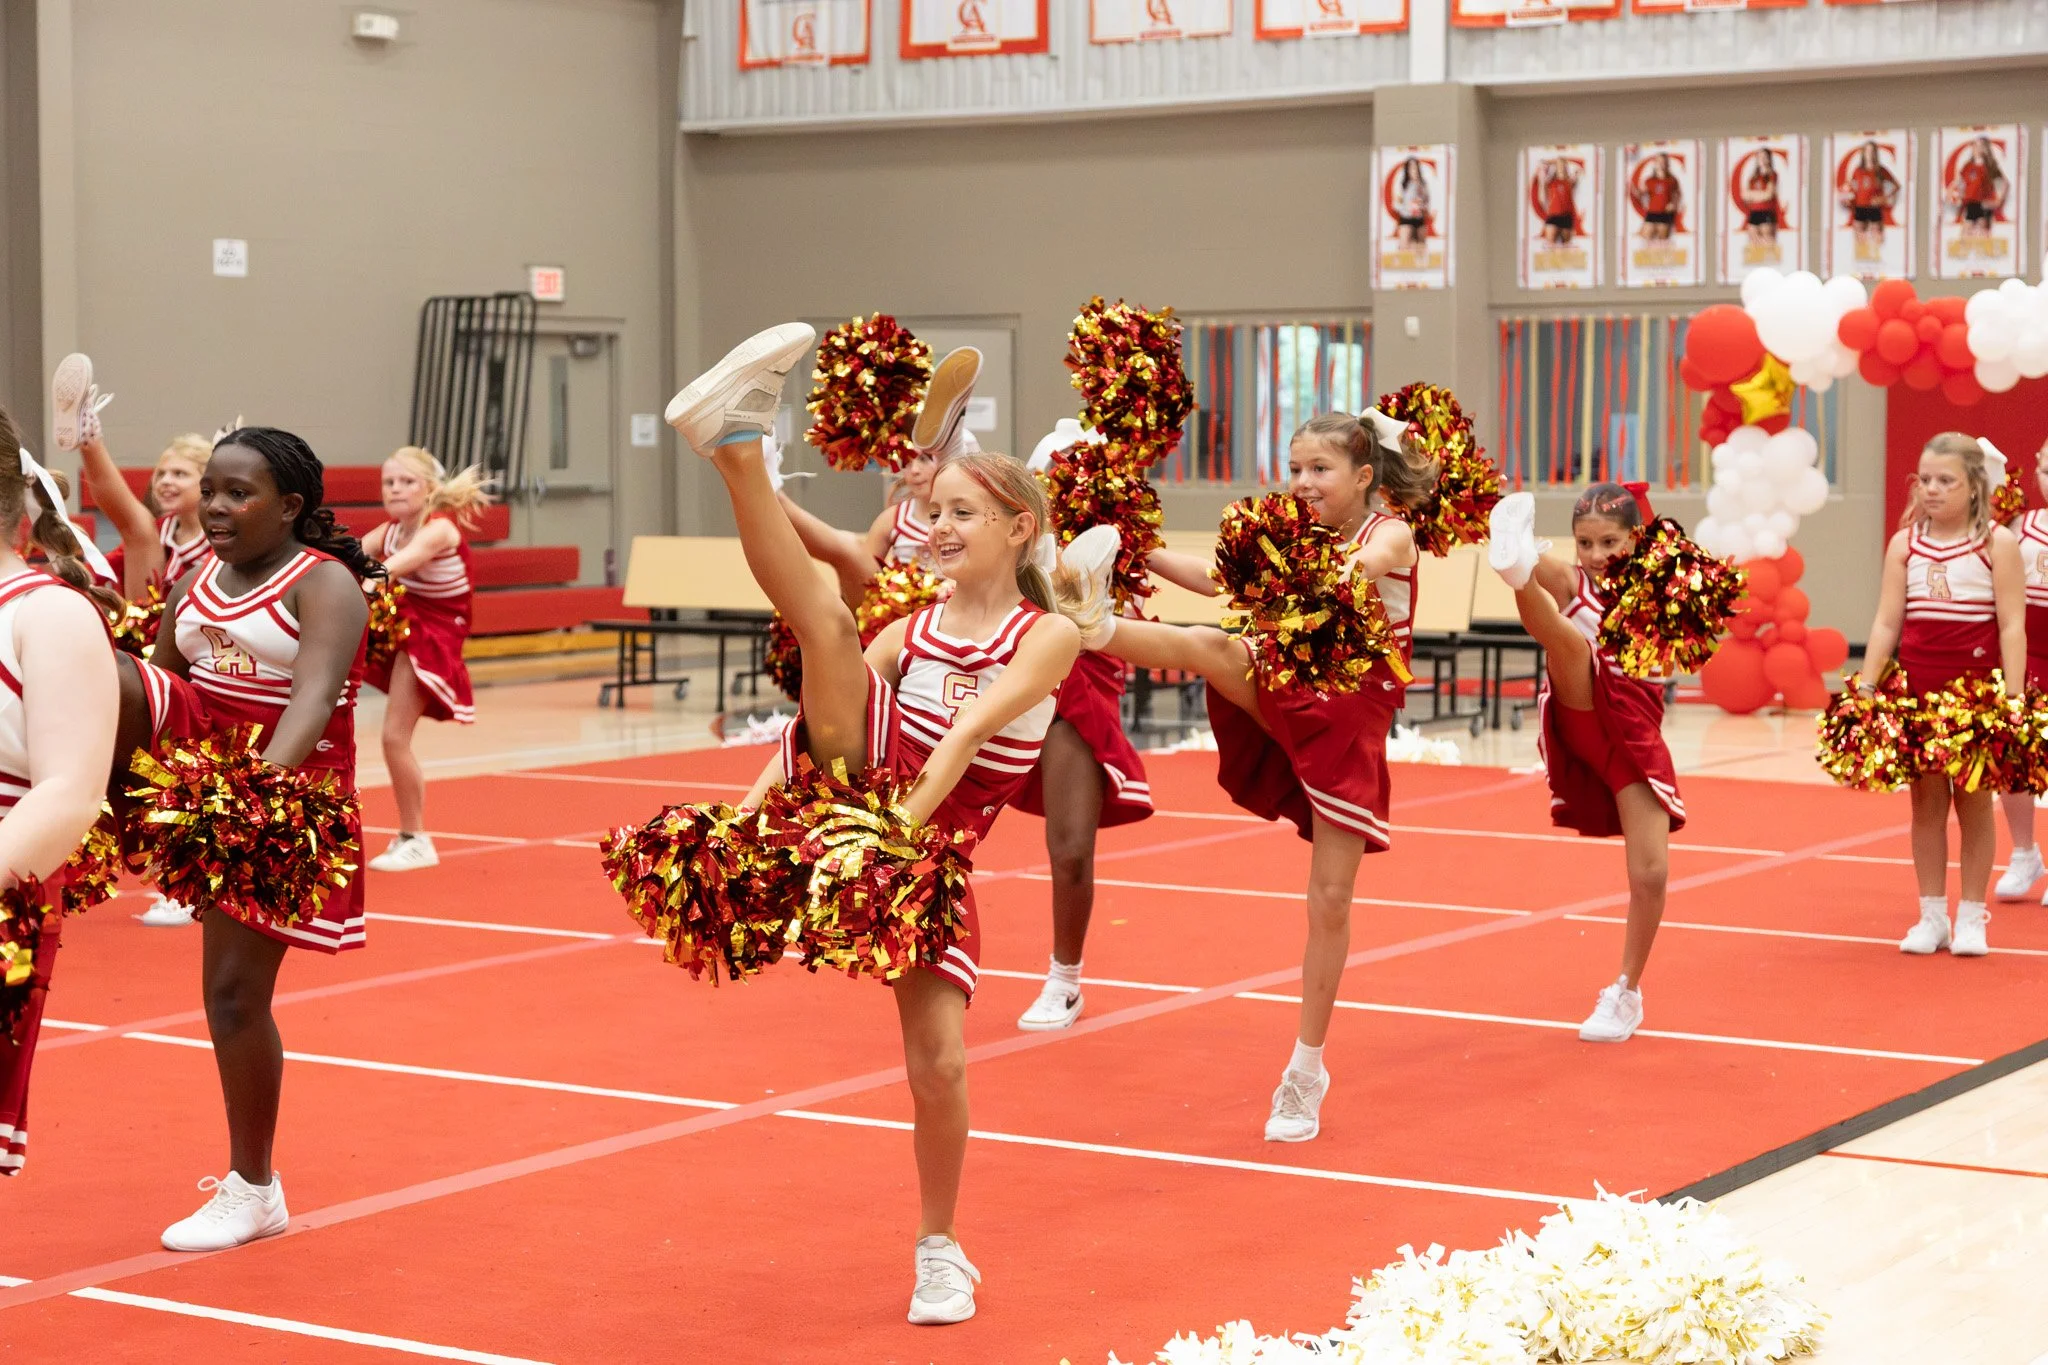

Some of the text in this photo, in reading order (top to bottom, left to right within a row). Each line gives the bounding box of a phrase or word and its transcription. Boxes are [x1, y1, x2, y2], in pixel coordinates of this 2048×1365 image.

[1384, 158, 1443, 239] C
[1927, 563, 1951, 600] CA
[201, 625, 257, 677] CA
[942, 671, 979, 726] C
